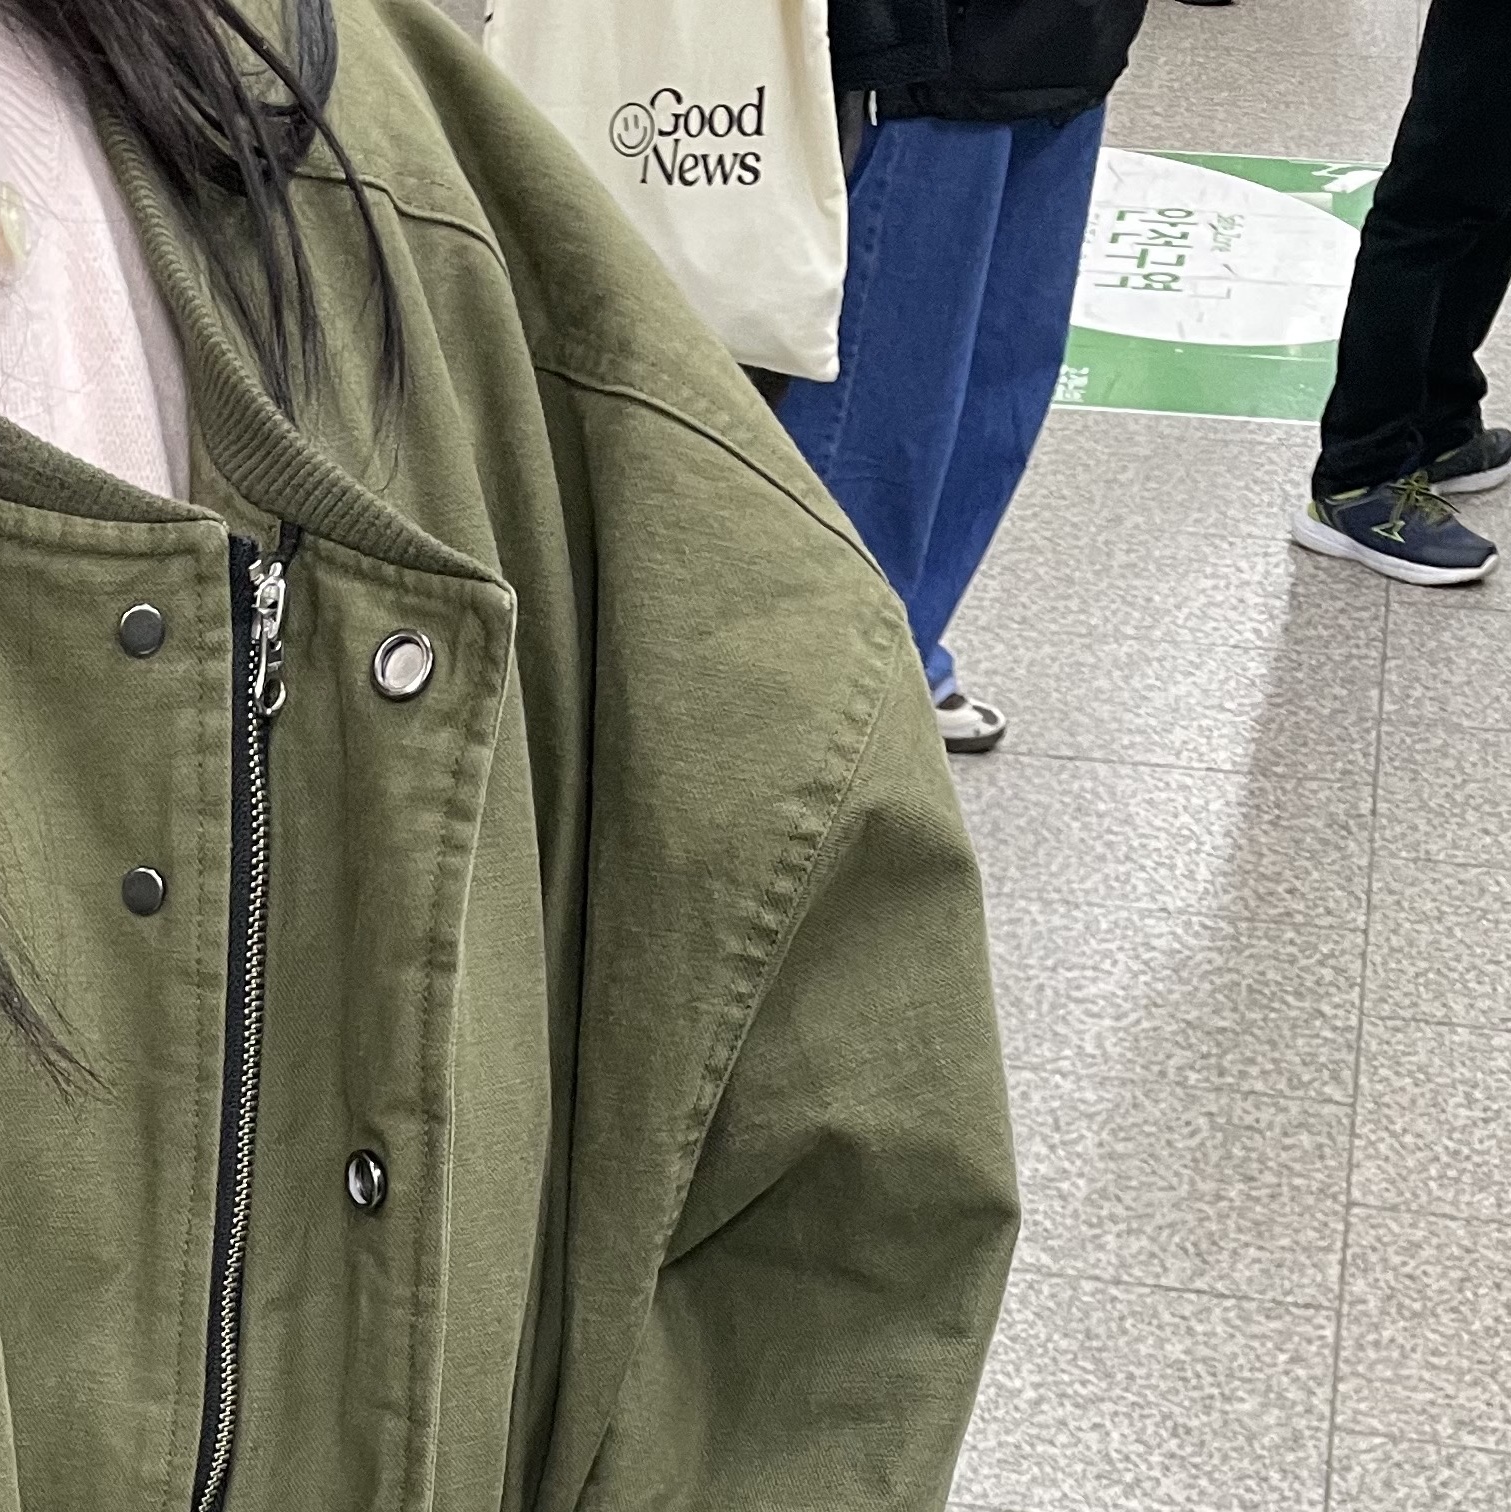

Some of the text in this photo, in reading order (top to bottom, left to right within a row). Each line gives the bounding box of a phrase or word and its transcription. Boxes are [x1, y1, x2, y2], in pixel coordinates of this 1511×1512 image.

[649, 84, 766, 138] Good
[640, 138, 761, 187] News
[1094, 208, 1199, 292] 안전구역
